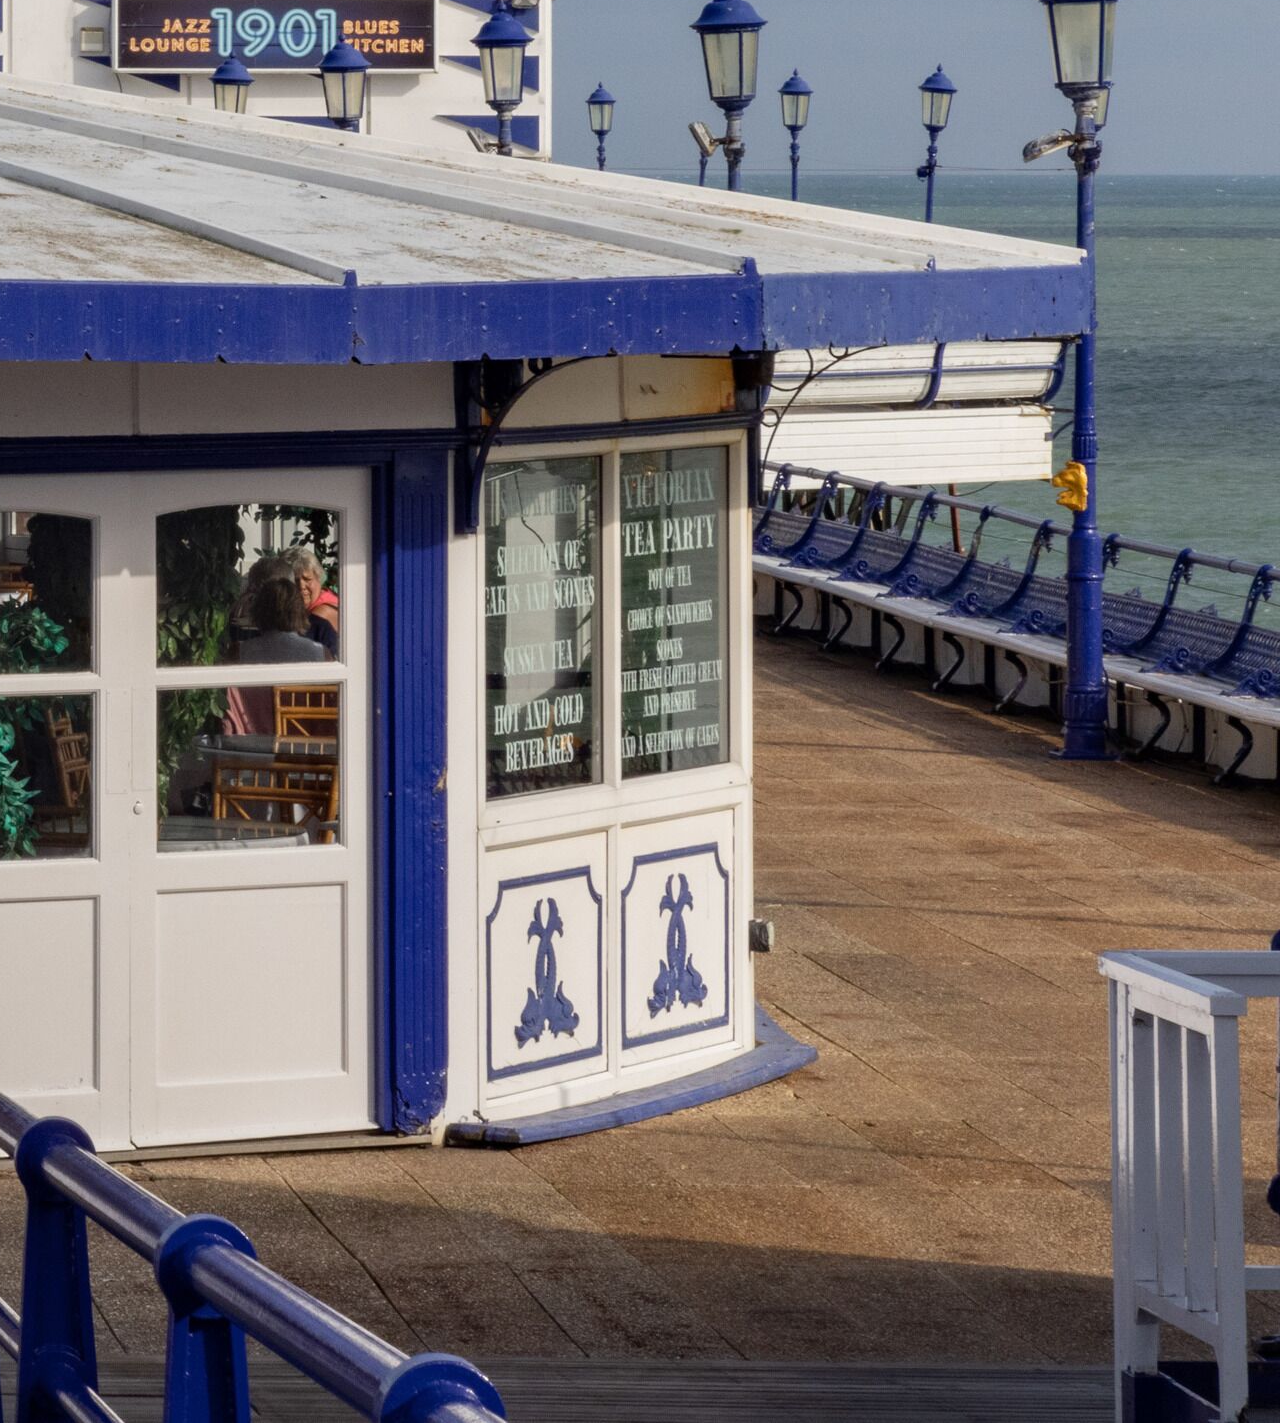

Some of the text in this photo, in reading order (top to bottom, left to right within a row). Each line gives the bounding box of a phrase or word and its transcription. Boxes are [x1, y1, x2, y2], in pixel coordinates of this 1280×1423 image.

[161, 18, 212, 34] JAZZ
[210, 7, 337, 57] 1901
[342, 19, 400, 35] BLUES
[129, 37, 212, 53] LOUNGE
[622, 468, 716, 509] VICTORIAN
[622, 514, 716, 557] TEA PARTY
[497, 539, 580, 577] SELECTION OF
[526, 581, 548, 611] AND
[553, 576, 595, 609] SCONES
[648, 565, 692, 591] POT OF TEA
[627, 599, 713, 632] CHOICE OF SANDWICHES
[504, 639, 574, 677] SUSSEX TEA
[656, 637, 683, 661] SCONES
[621, 670, 638, 693] ITH
[639, 667, 662, 691] FRESH
[664, 663, 697, 687] CLOTTED
[494, 693, 584, 736] HOT AND COLD
[643, 689, 697, 717] AND PRESERVE
[505, 732, 575, 773] BEVERAGES
[638, 734, 644, 756] A
[645, 728, 684, 755] SELECTION
[685, 727, 695, 749] OF
[697, 723, 720, 747] CAKES
